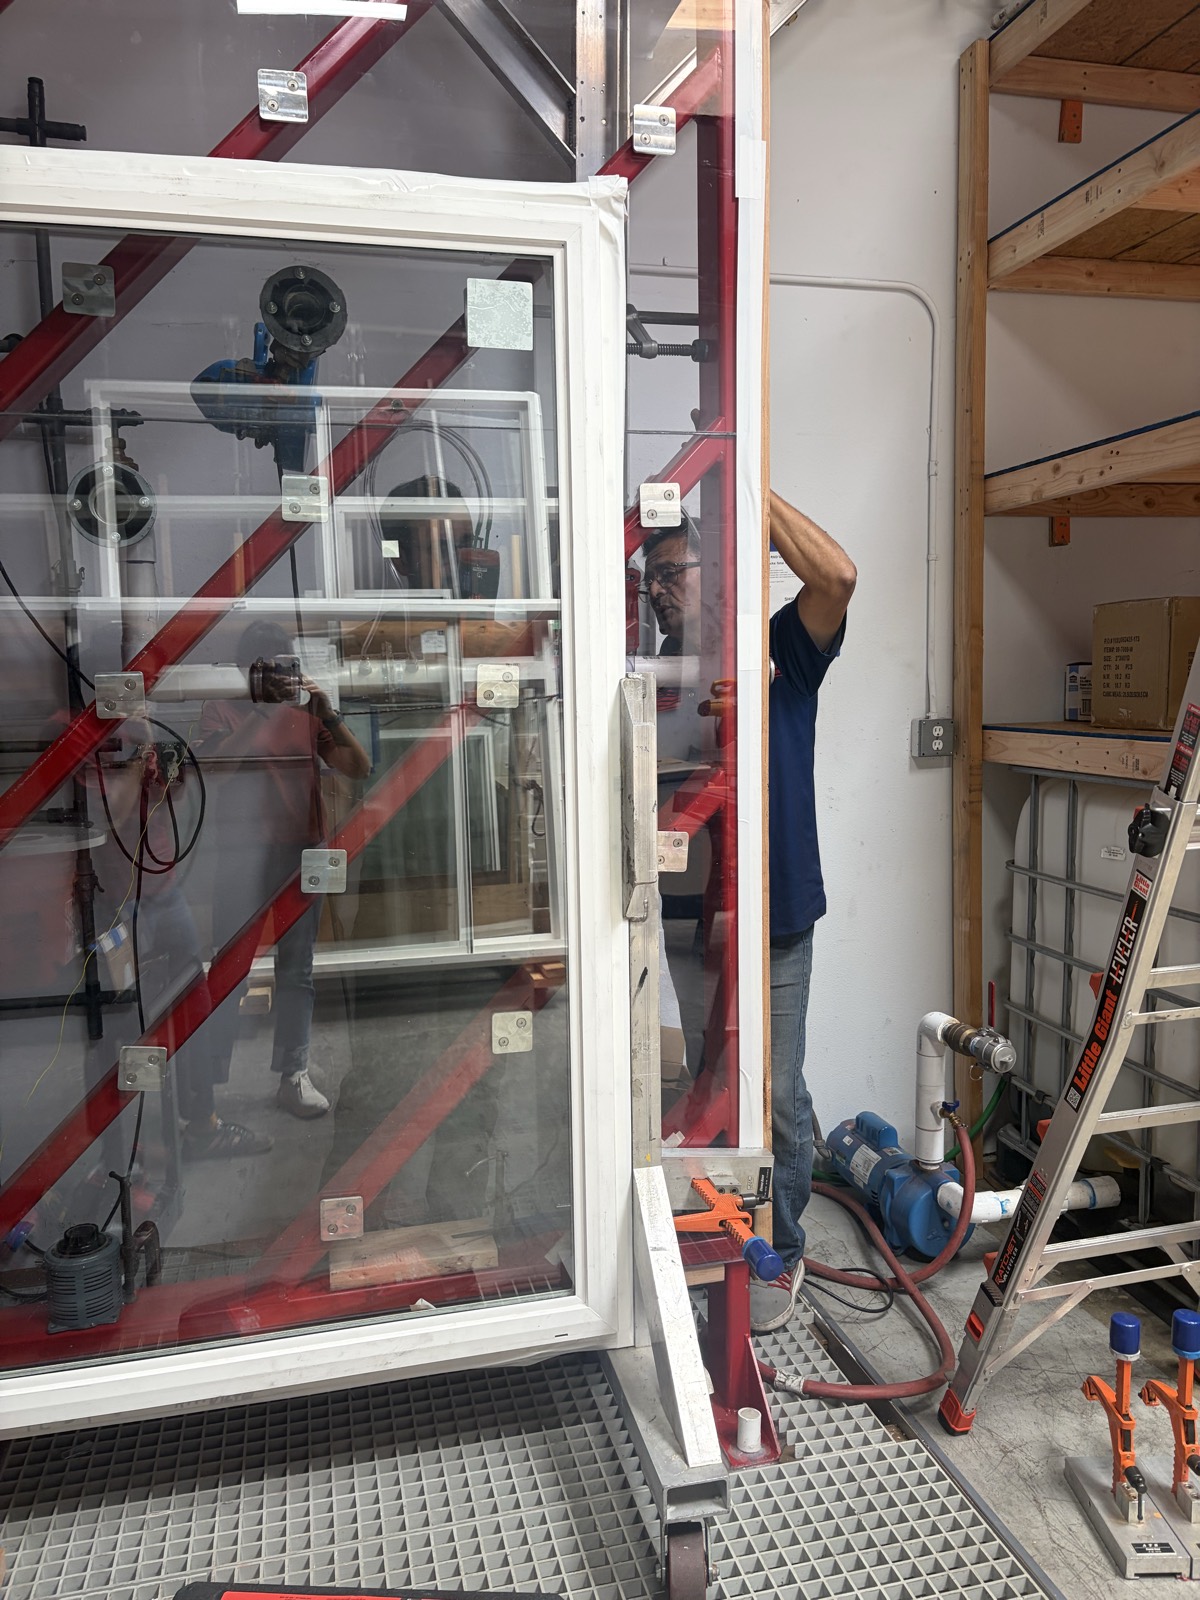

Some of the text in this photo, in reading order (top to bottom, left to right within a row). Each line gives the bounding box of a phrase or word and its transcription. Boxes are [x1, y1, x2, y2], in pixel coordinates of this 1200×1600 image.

[1133, 880, 1149, 896] Giant
[1135, 873, 1150, 889] Little
[1073, 915, 1139, 1092] Little Giant LEVELER
[994, 1234, 1017, 1285] RATCHET
